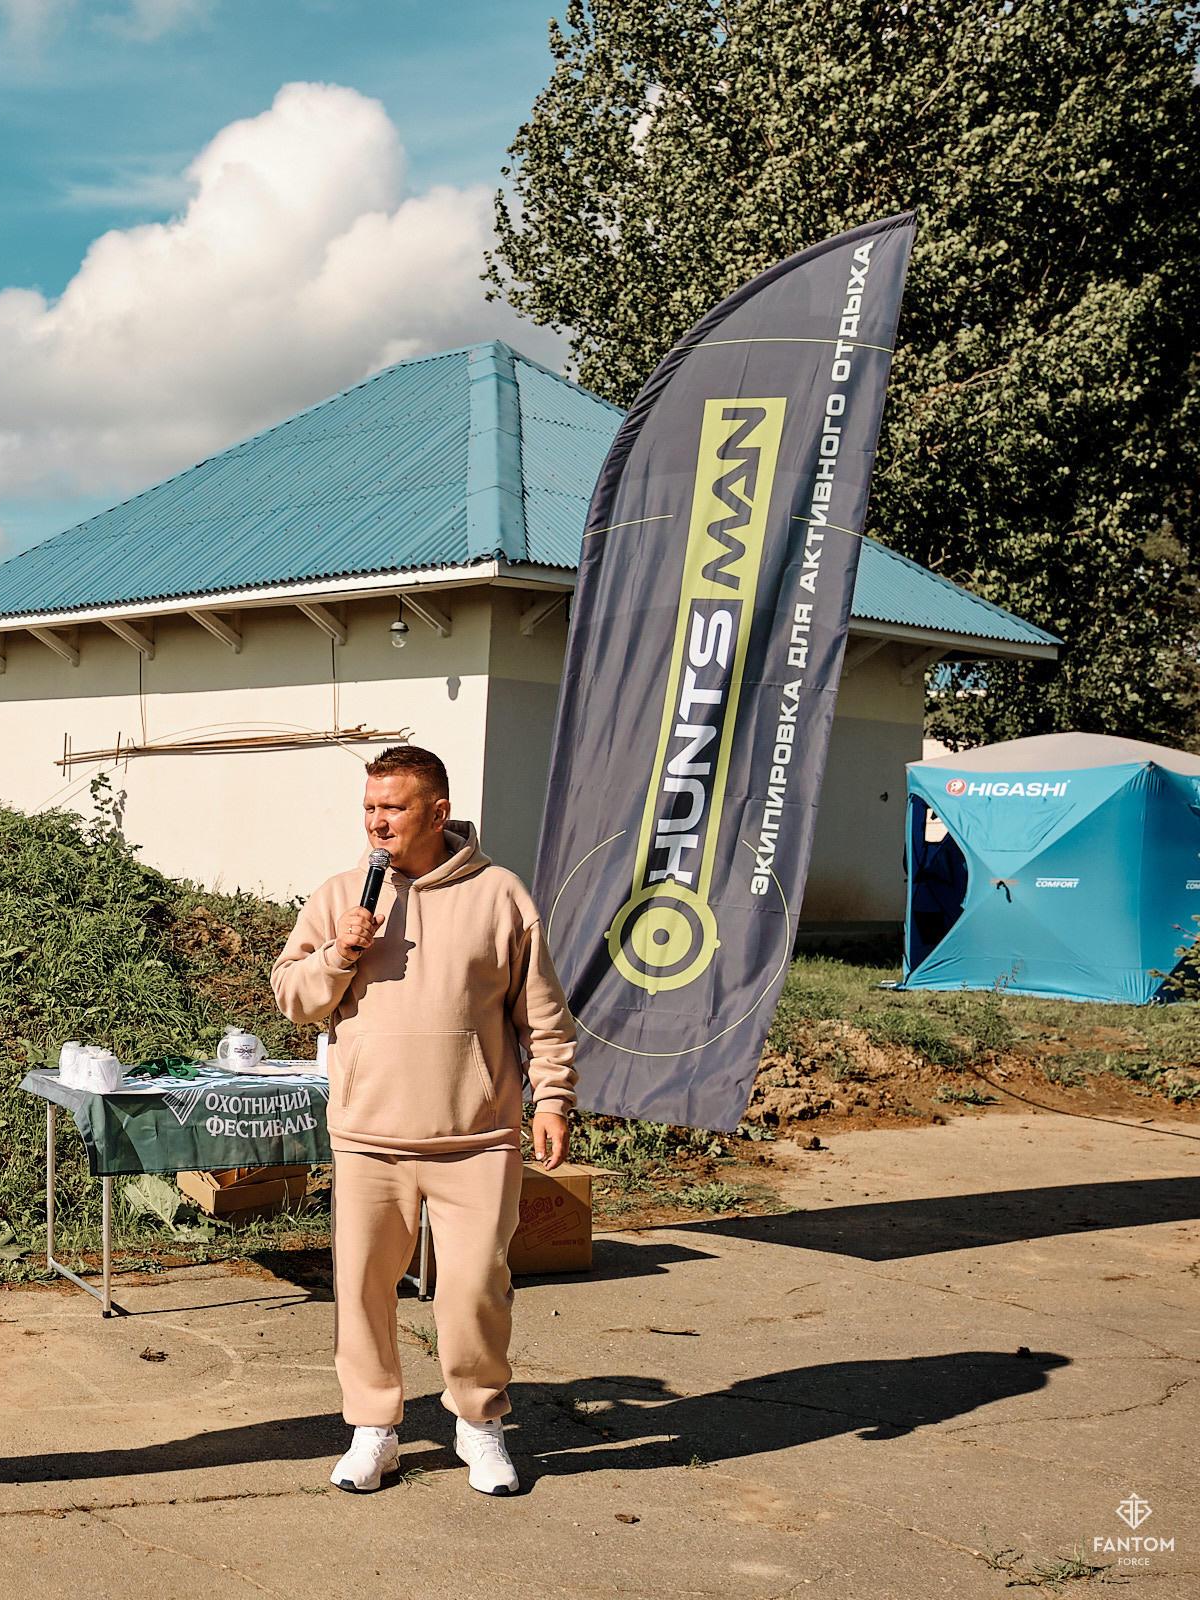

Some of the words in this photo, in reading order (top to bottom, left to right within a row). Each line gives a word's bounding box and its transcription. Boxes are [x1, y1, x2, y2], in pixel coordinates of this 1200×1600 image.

[750, 679, 802, 896] ЭКИПИРОВКА
[787, 603, 813, 669] ДЛЯ
[800, 394, 845, 594] АКТИВНОГО
[831, 241, 874, 382] ОТДЫХА
[967, 781, 1069, 797] HIGASHI
[1035, 880, 1079, 888] COMFORT
[205, 1086, 312, 1115] ОХОТНИЧИЙ
[205, 1112, 318, 1138] ФЕСТИВАЛЬ
